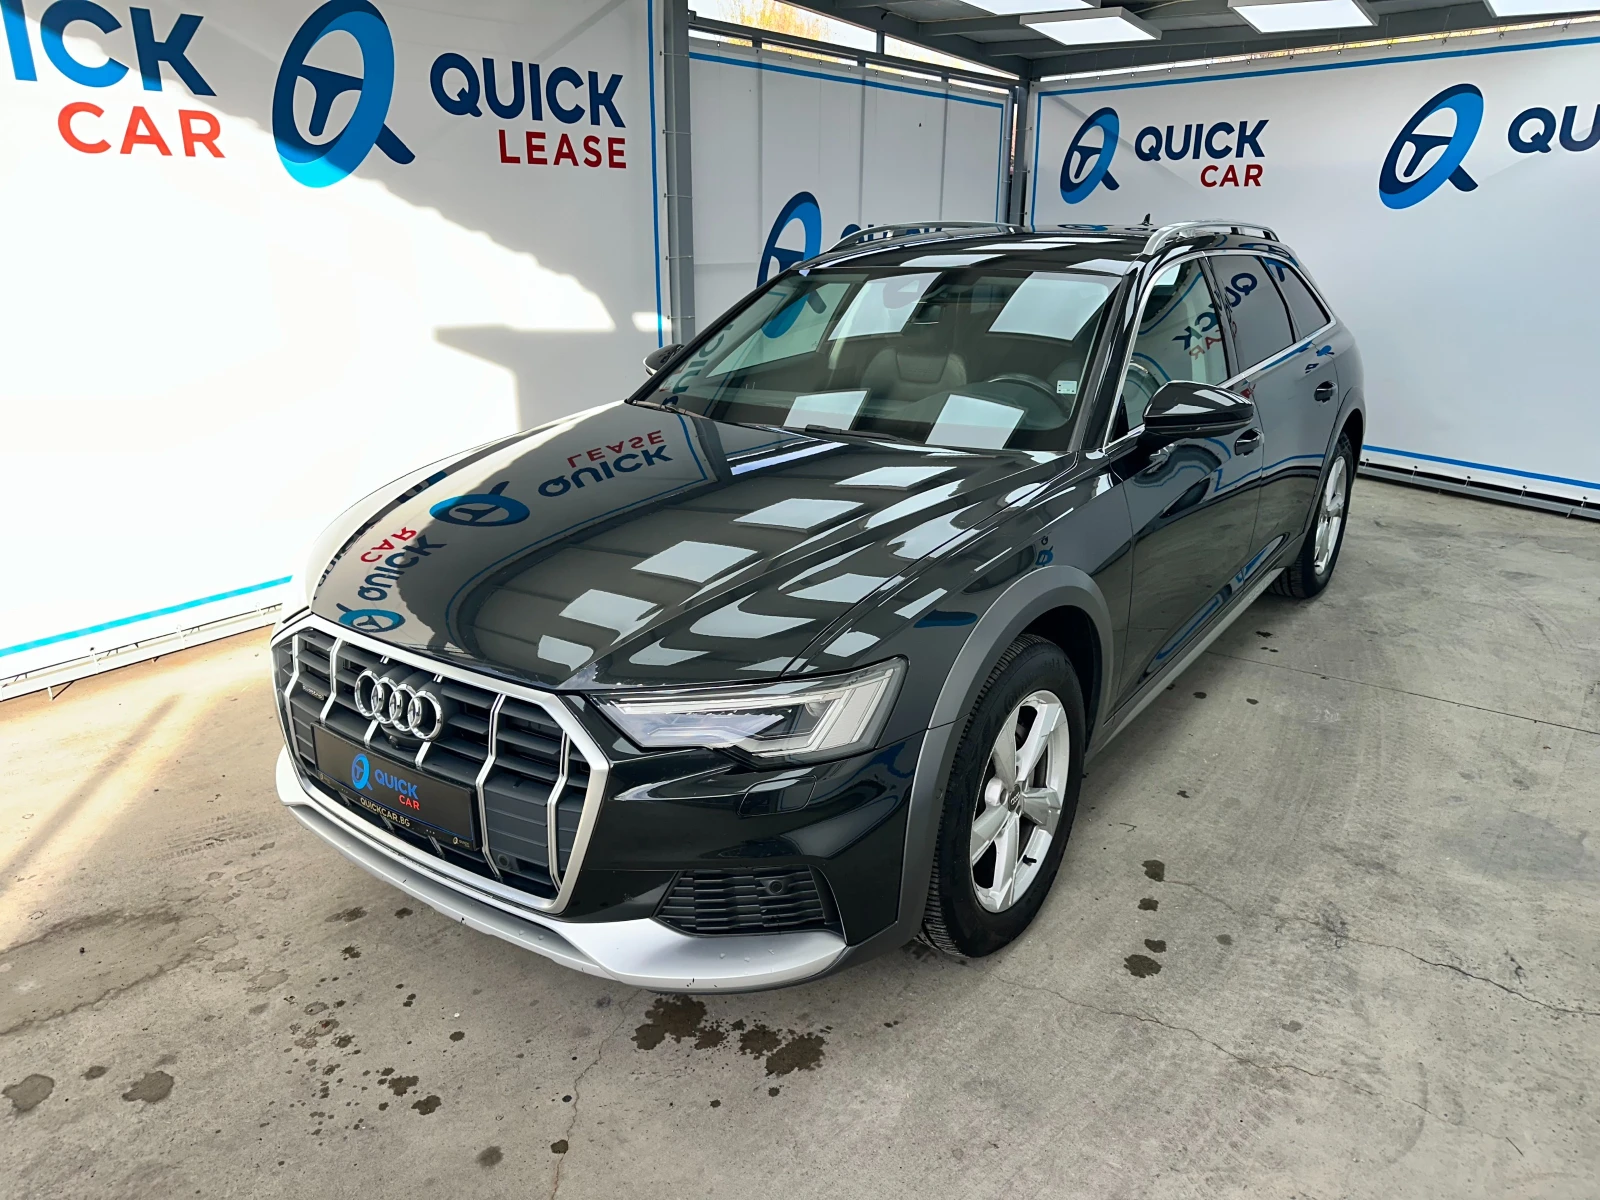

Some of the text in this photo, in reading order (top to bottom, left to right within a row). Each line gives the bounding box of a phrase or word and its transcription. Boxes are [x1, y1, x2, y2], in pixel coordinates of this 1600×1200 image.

[1, 0, 217, 97] ICK
[430, 52, 626, 128] QUICK
[58, 102, 226, 158] CAR
[498, 129, 627, 169] LEASE
[1135, 119, 1269, 161] QUICK
[1200, 164, 1263, 187] CAR
[375, 769, 418, 799] QUICK
[398, 794, 420, 810] CAR
[360, 797, 410, 827] QUICKCAR.BG
